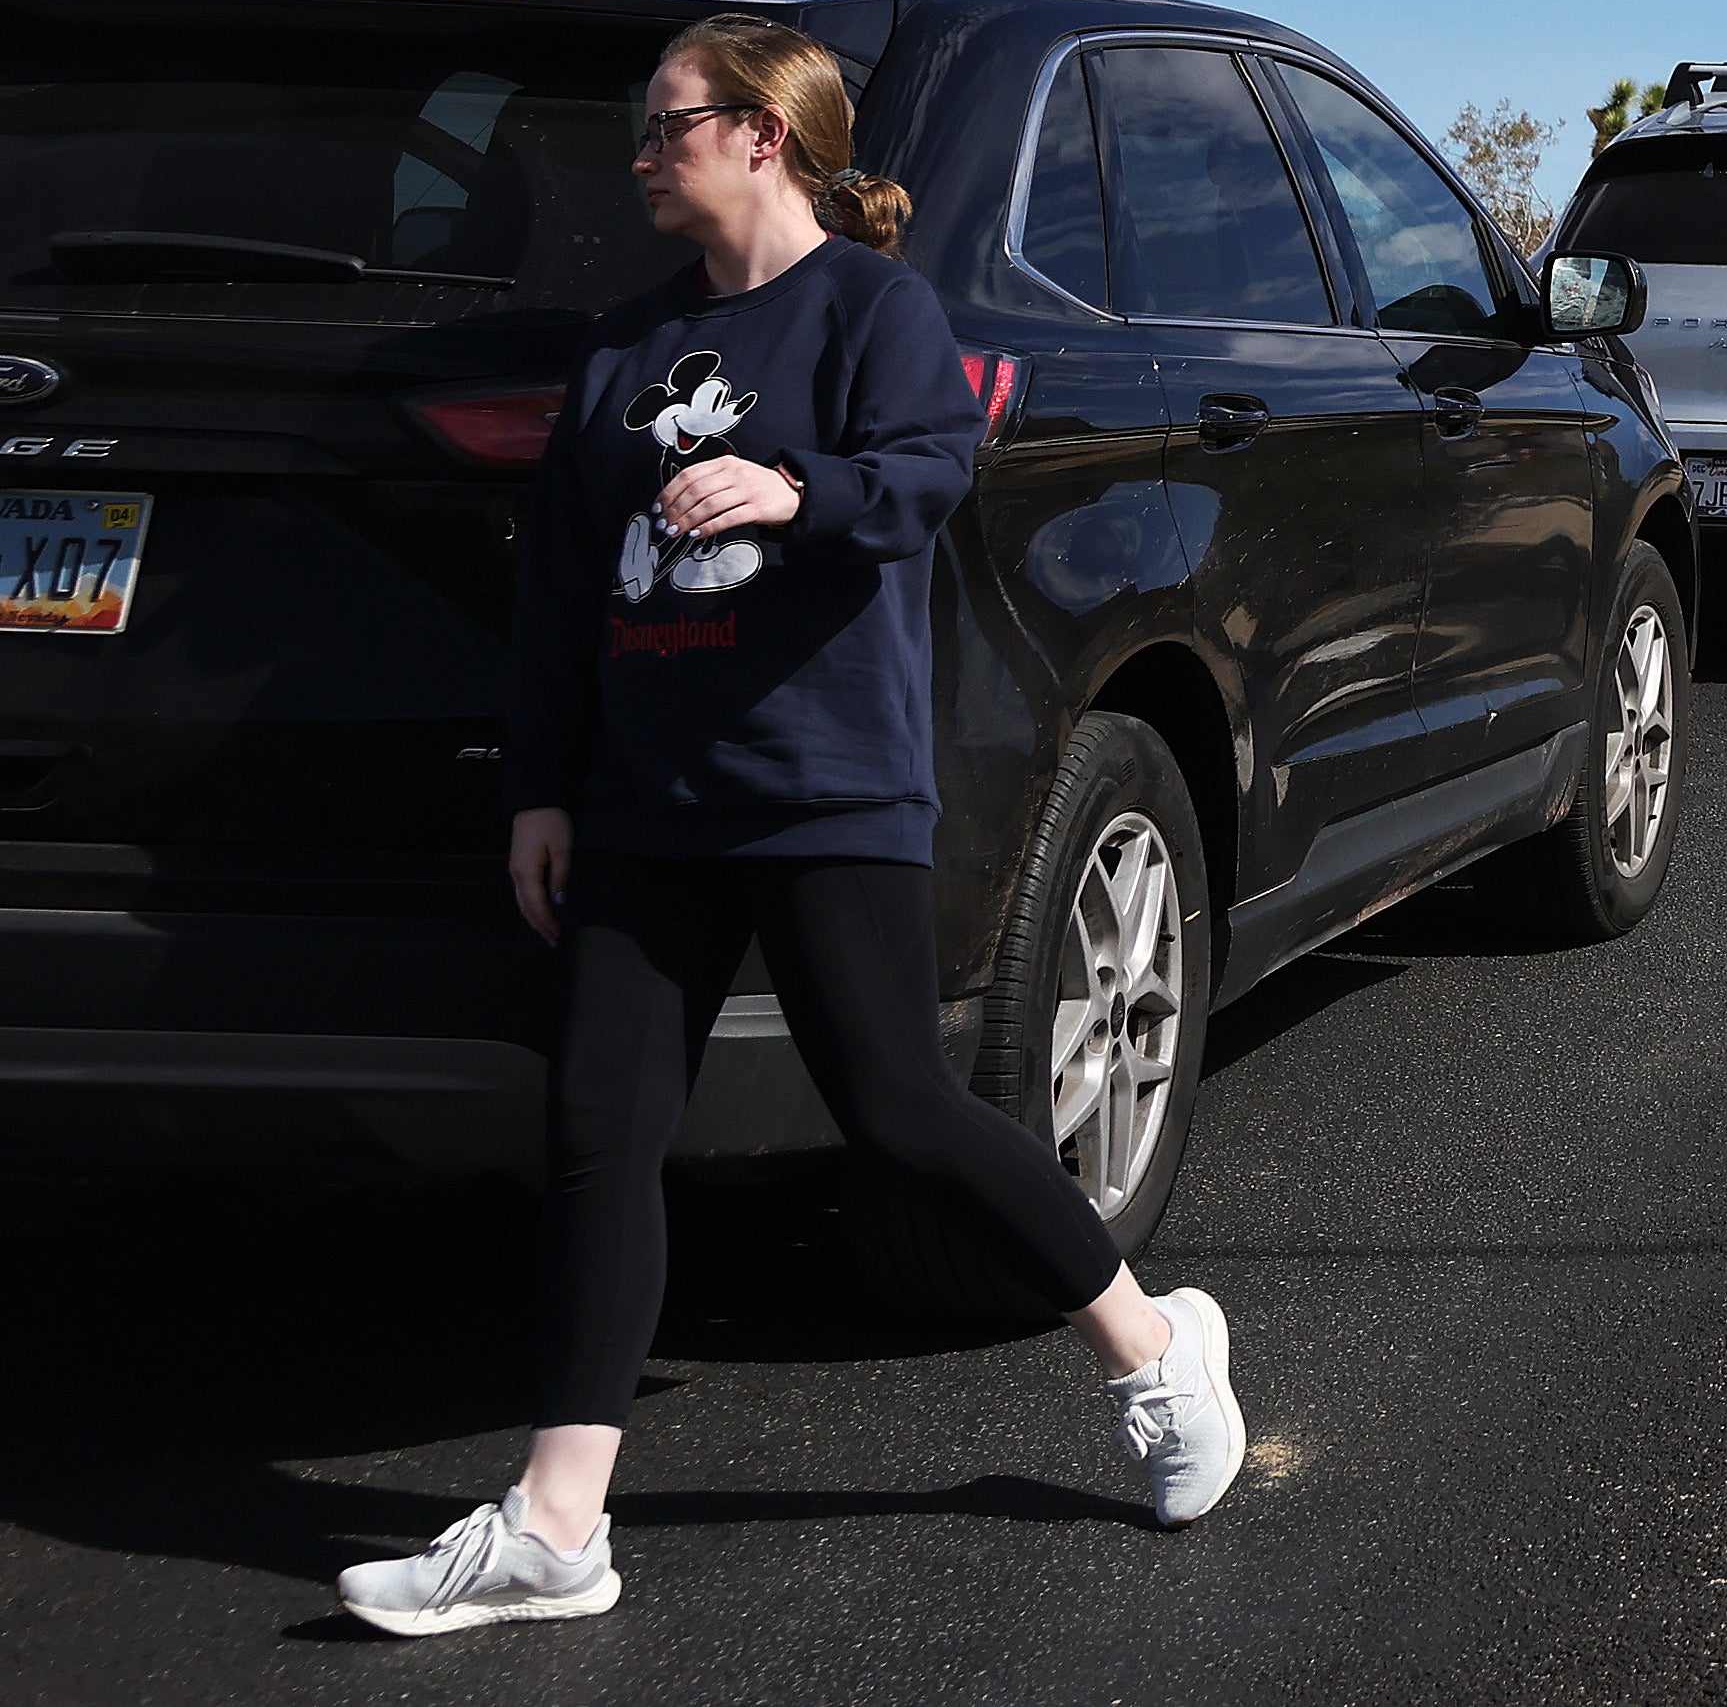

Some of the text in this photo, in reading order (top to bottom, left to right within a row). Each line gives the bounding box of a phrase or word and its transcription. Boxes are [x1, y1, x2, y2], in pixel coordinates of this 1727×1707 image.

[0, 437, 120, 457] GE
[1691, 464, 1706, 473] DEC
[110, 508, 130, 522] 04
[608, 609, 738, 659] Disneyland
